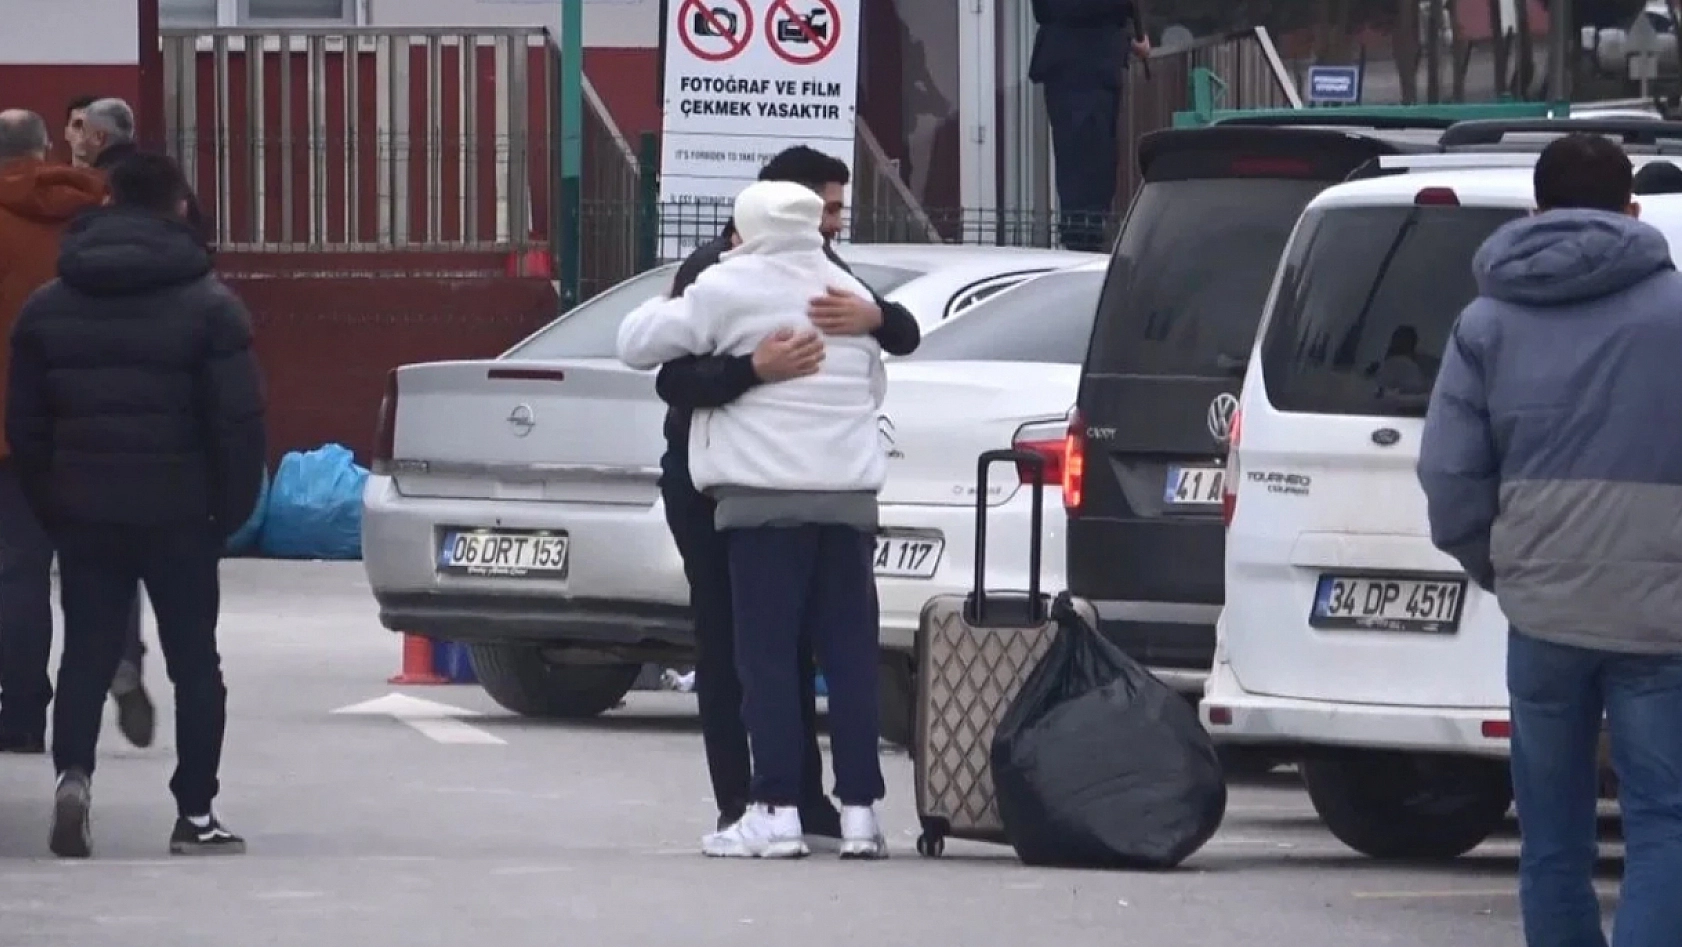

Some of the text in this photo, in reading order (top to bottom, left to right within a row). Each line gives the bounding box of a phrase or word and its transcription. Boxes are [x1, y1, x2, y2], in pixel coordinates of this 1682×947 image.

[681, 76, 841, 97] FOTOĞRAF VE FİLM
[681, 100, 840, 120] ÇEKMEK YASAKTIR
[1176, 472, 1200, 501] 41
[1247, 471, 1311, 486] TOURNEO
[453, 535, 563, 567] 06 DRT 153
[873, 541, 932, 570] A 117
[1329, 581, 1457, 618] 34 DP 4511
